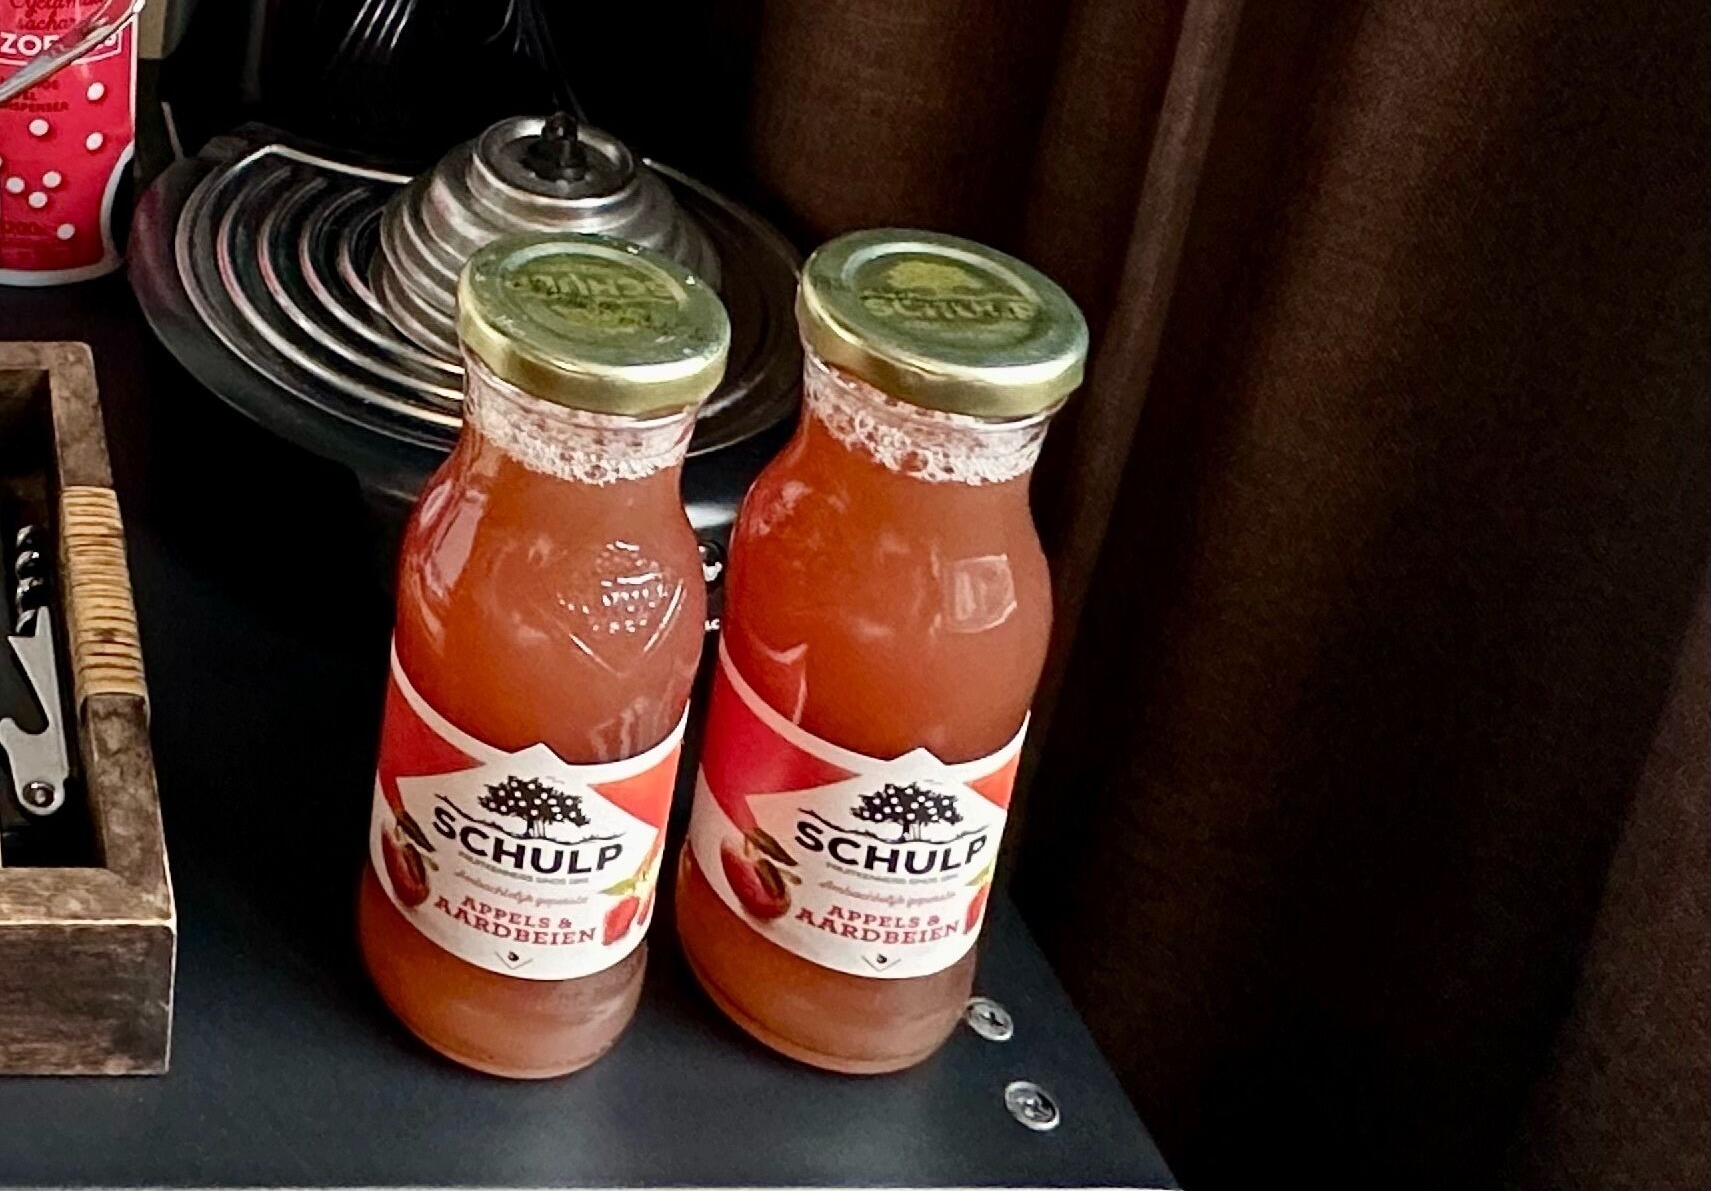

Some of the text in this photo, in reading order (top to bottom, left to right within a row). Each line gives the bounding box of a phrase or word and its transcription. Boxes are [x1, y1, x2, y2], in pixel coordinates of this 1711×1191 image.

[431, 805, 624, 876] SCHULP
[794, 820, 989, 876] SCHULP
[433, 895, 597, 945] AARDBEIEN
[461, 895, 573, 929] APPELS &
[794, 907, 961, 944] AARDBEIEN
[827, 905, 941, 929] APPELS &
